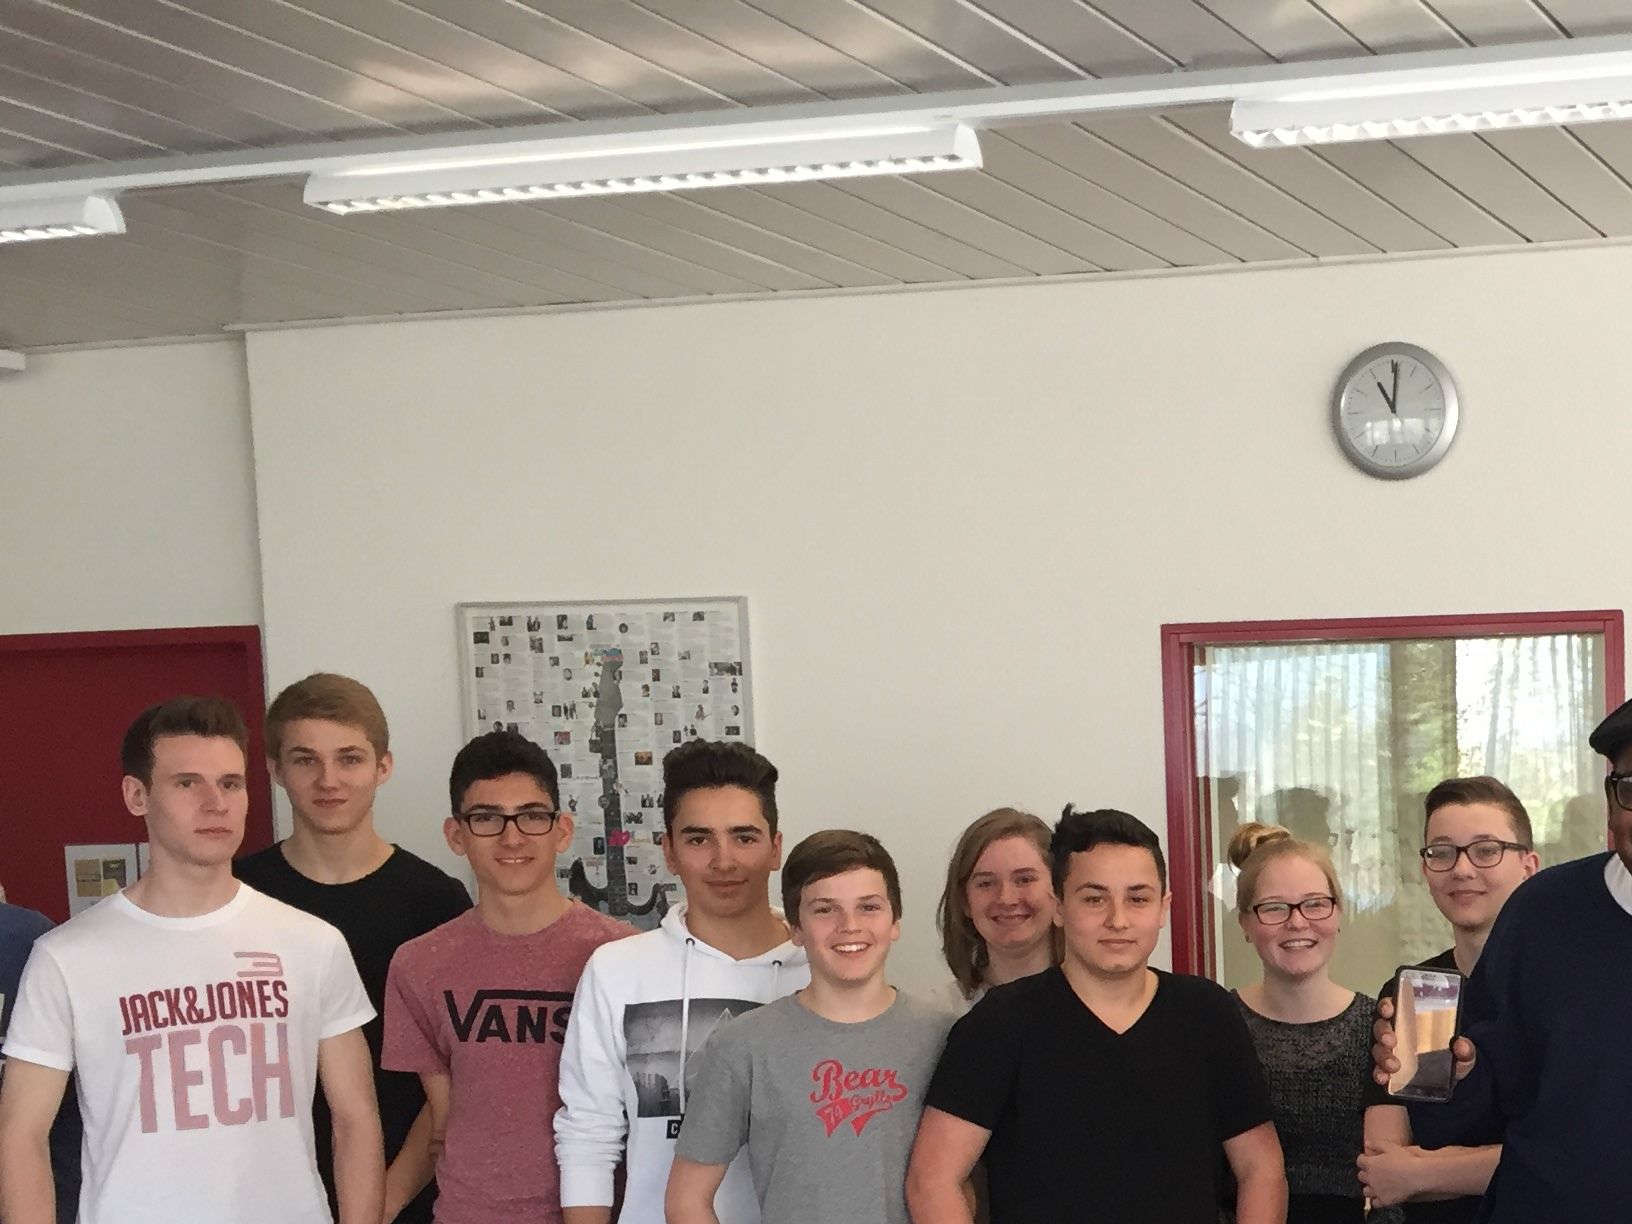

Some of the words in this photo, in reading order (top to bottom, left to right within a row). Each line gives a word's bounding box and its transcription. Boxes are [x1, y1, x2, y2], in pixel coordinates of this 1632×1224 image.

[118, 980, 289, 1036] JACK&JONES
[125, 1022, 295, 1134] TECH
[810, 1059, 903, 1103] Bear
